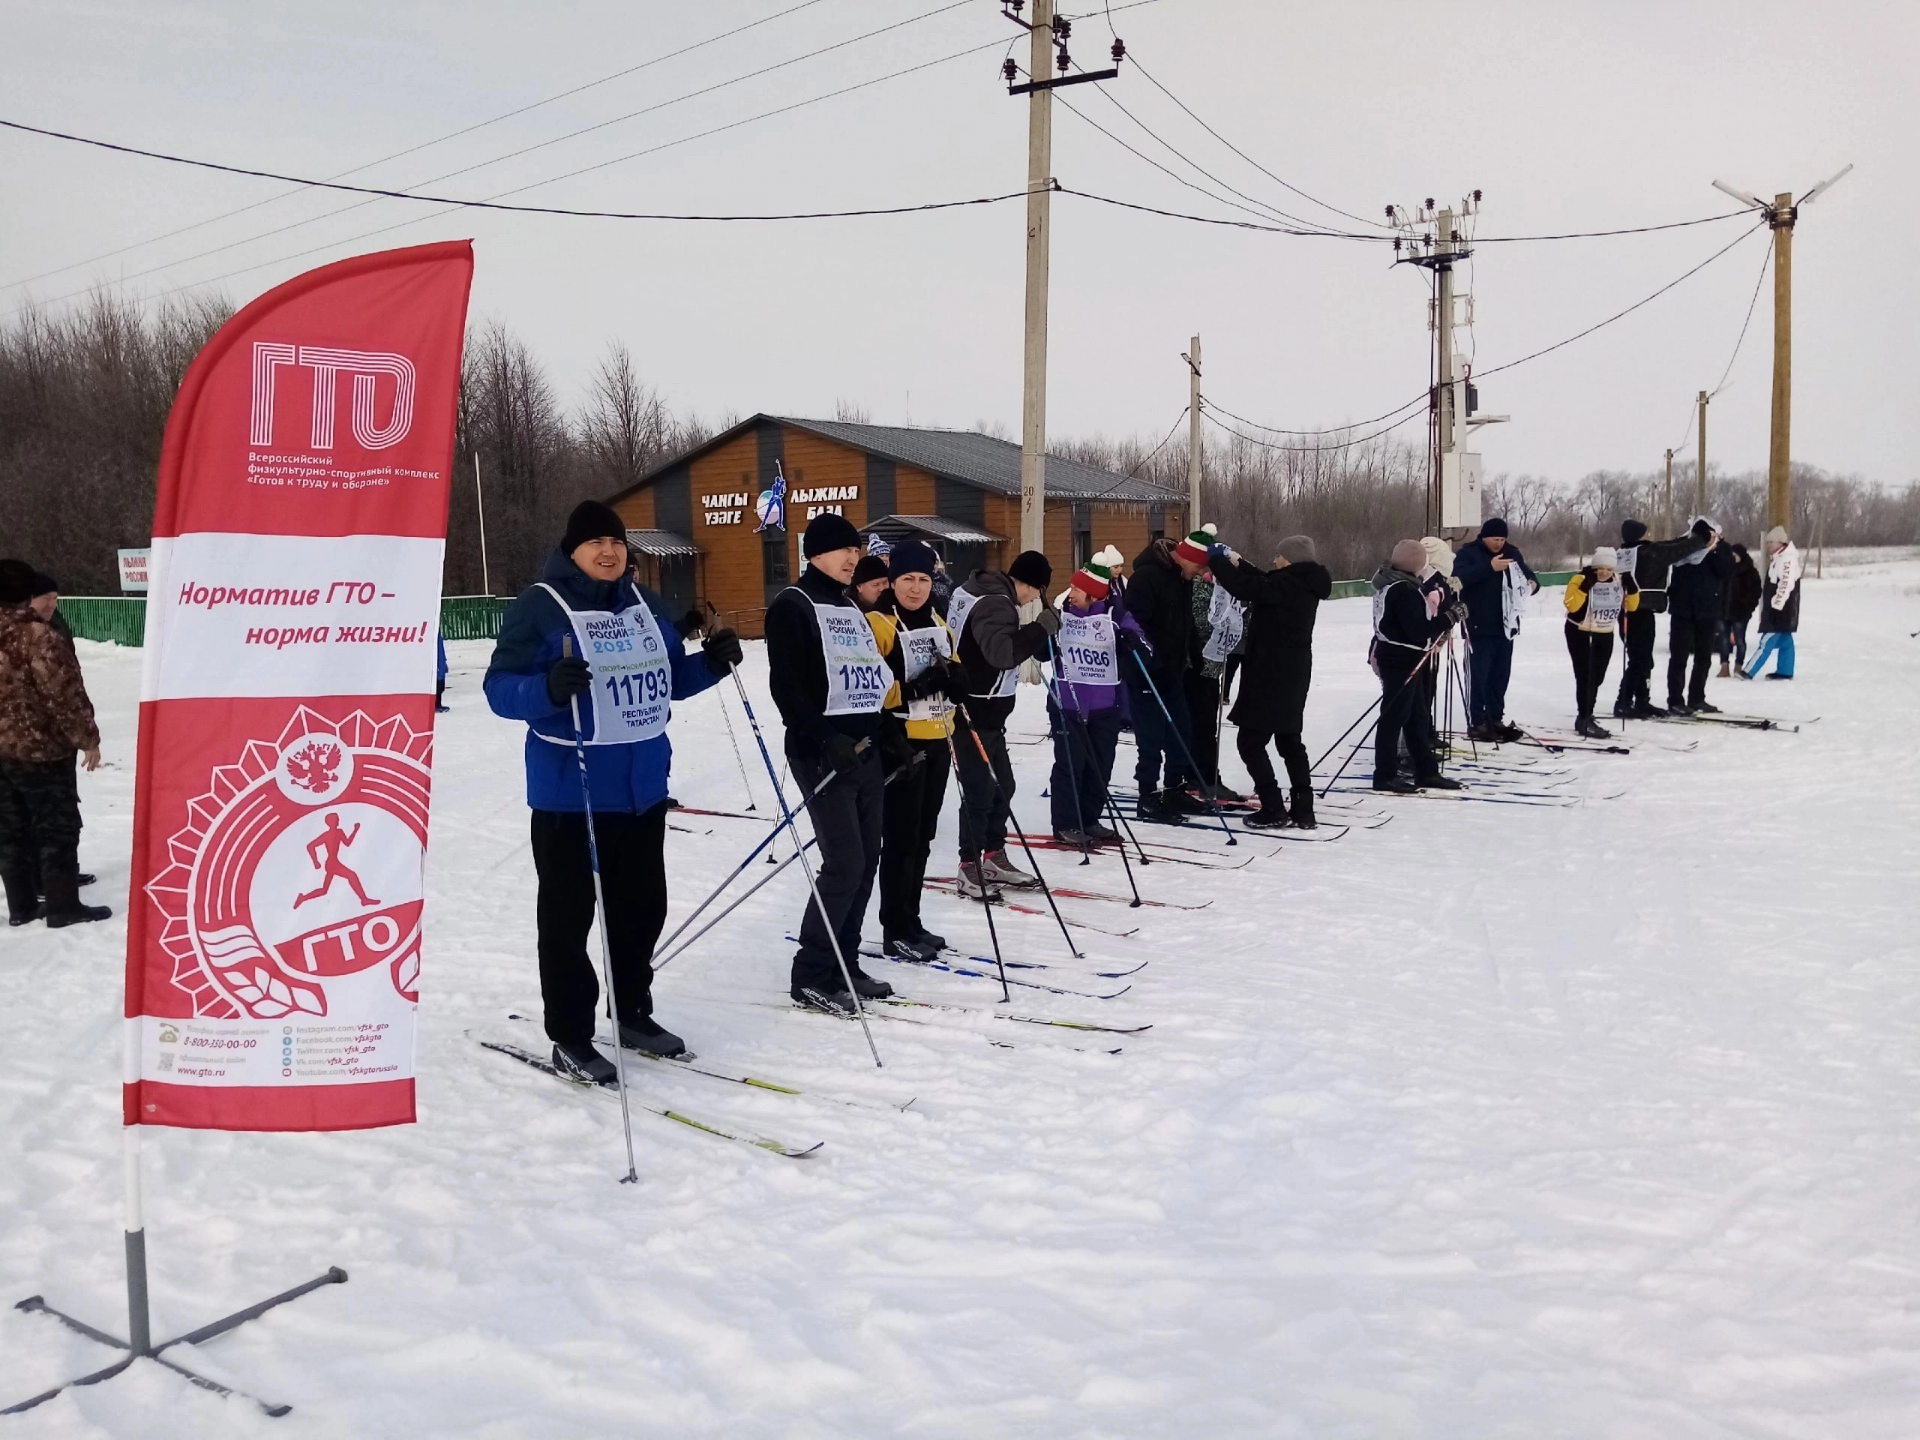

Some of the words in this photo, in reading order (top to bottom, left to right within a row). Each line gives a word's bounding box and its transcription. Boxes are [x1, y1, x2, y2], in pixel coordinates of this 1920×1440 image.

[250, 342, 415, 450] ГТО
[248, 452, 333, 465] Всероссийский
[247, 464, 392, 480] физкультурно-спортивный
[394, 468, 440, 480] комплекс
[287, 478, 294, 486] к
[296, 479, 329, 489] труду
[1023, 486, 1034, 496] 20
[790, 485, 858, 503] ЛЫЖНАЯ
[178, 581, 321, 610] Норматив
[325, 581, 376, 604] ГТО
[245, 626, 330, 650] норма
[335, 622, 428, 643] жизни!
[588, 628, 629, 639] РОССИИ
[832, 634, 859, 646] 2023
[593, 639, 633, 653] 2023
[1068, 646, 1110, 667] 11686
[839, 665, 886, 690] 11921
[606, 668, 668, 706] 11793
[626, 715, 659, 728] ТАТАРСТАН
[302, 915, 399, 972] ГТО
[177, 1067, 225, 1077] www.gto.ru
